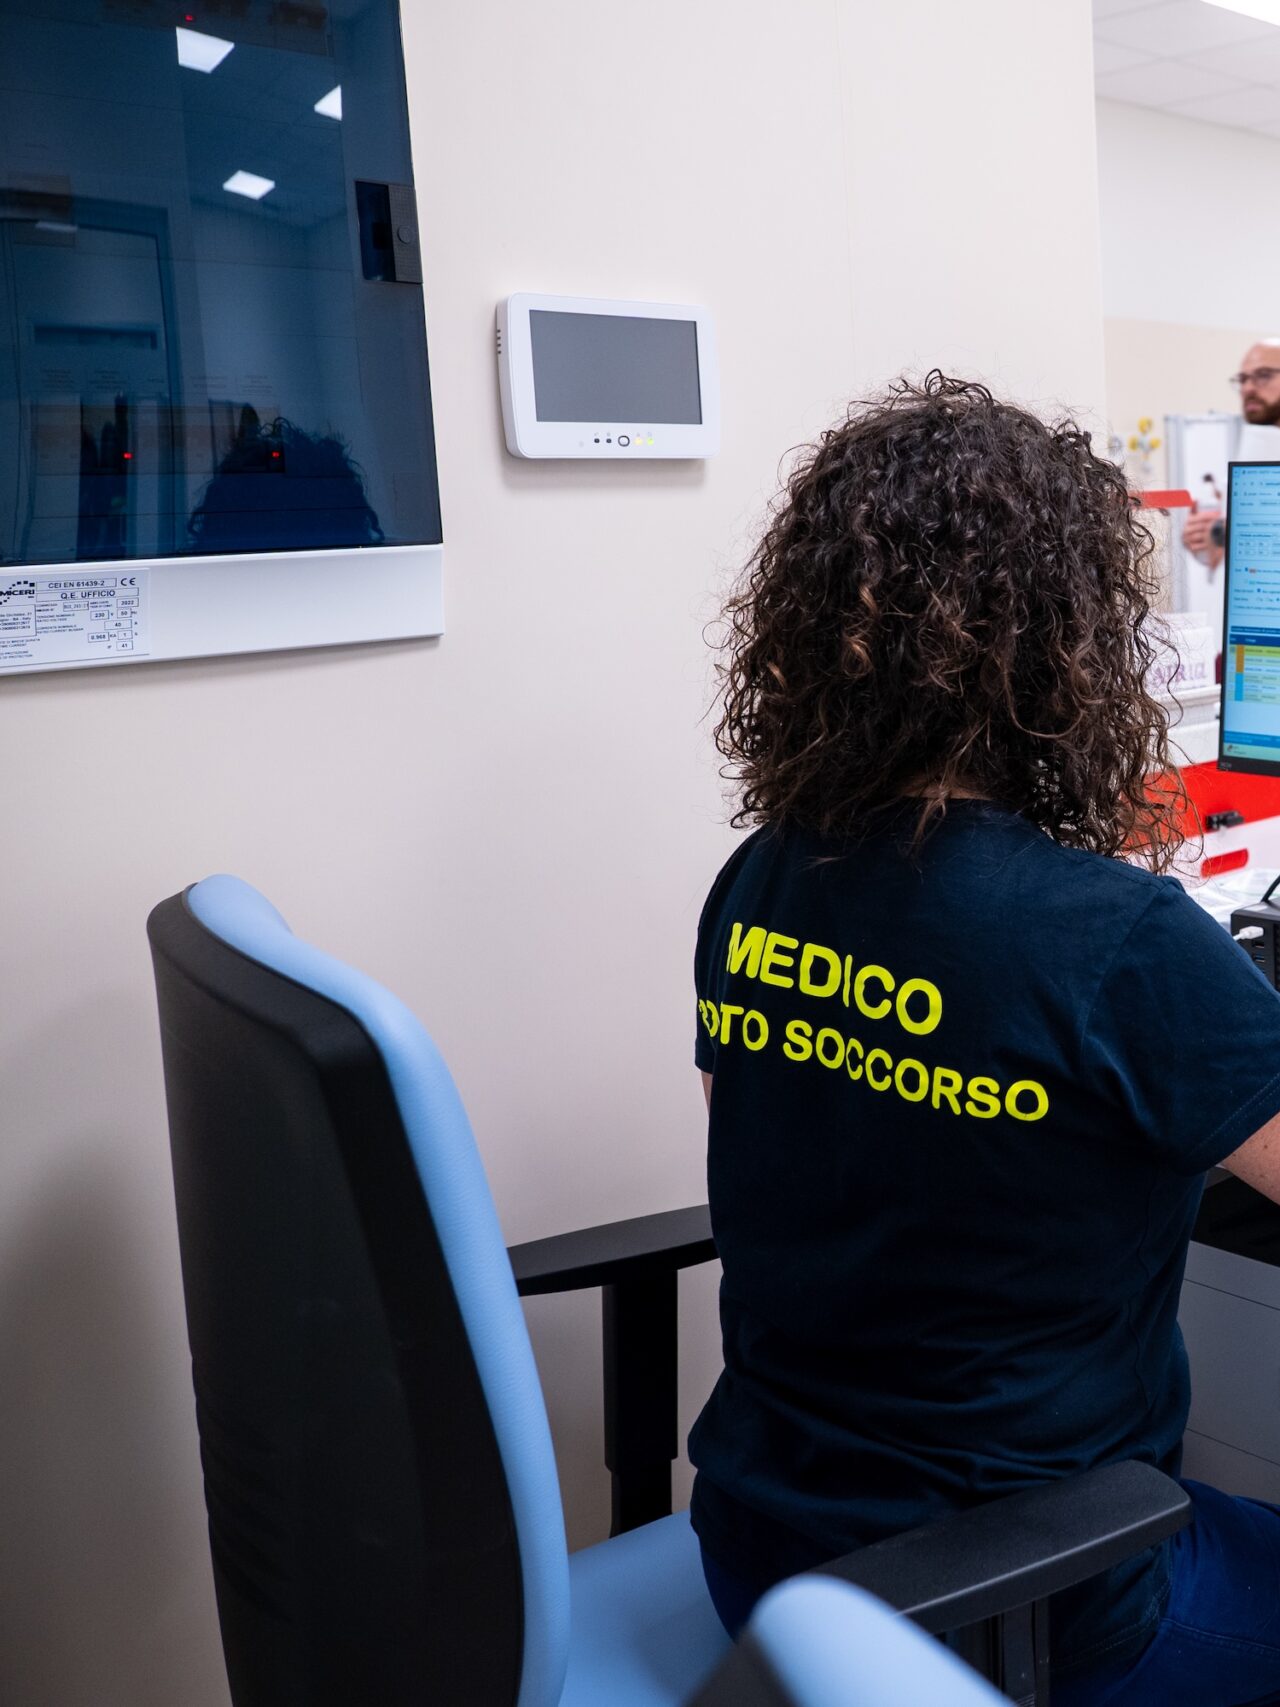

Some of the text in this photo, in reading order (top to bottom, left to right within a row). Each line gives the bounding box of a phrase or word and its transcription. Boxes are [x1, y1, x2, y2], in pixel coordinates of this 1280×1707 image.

[81, 590, 116, 598] UFFICIO
[726, 922, 943, 1036] MEDICO
[782, 1019, 1050, 1122] SOCCORSO
